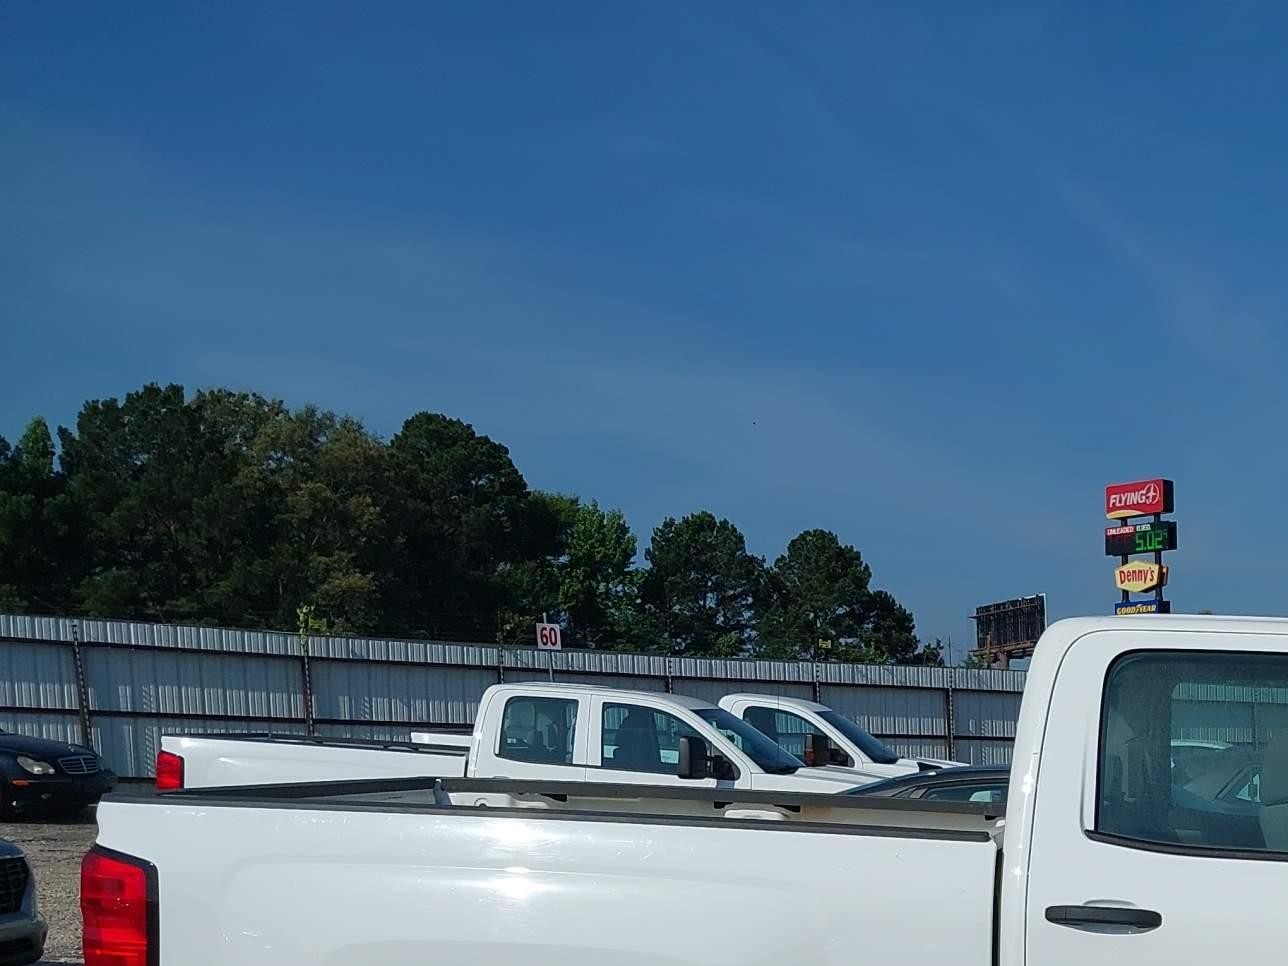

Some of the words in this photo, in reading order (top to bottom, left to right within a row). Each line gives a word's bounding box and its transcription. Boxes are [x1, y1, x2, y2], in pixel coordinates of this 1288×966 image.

[1109, 489, 1146, 508] FLYING
[1119, 566, 1154, 584] Denny's
[1116, 604, 1156, 615] GOODYEAR
[540, 627, 557, 646] 60
